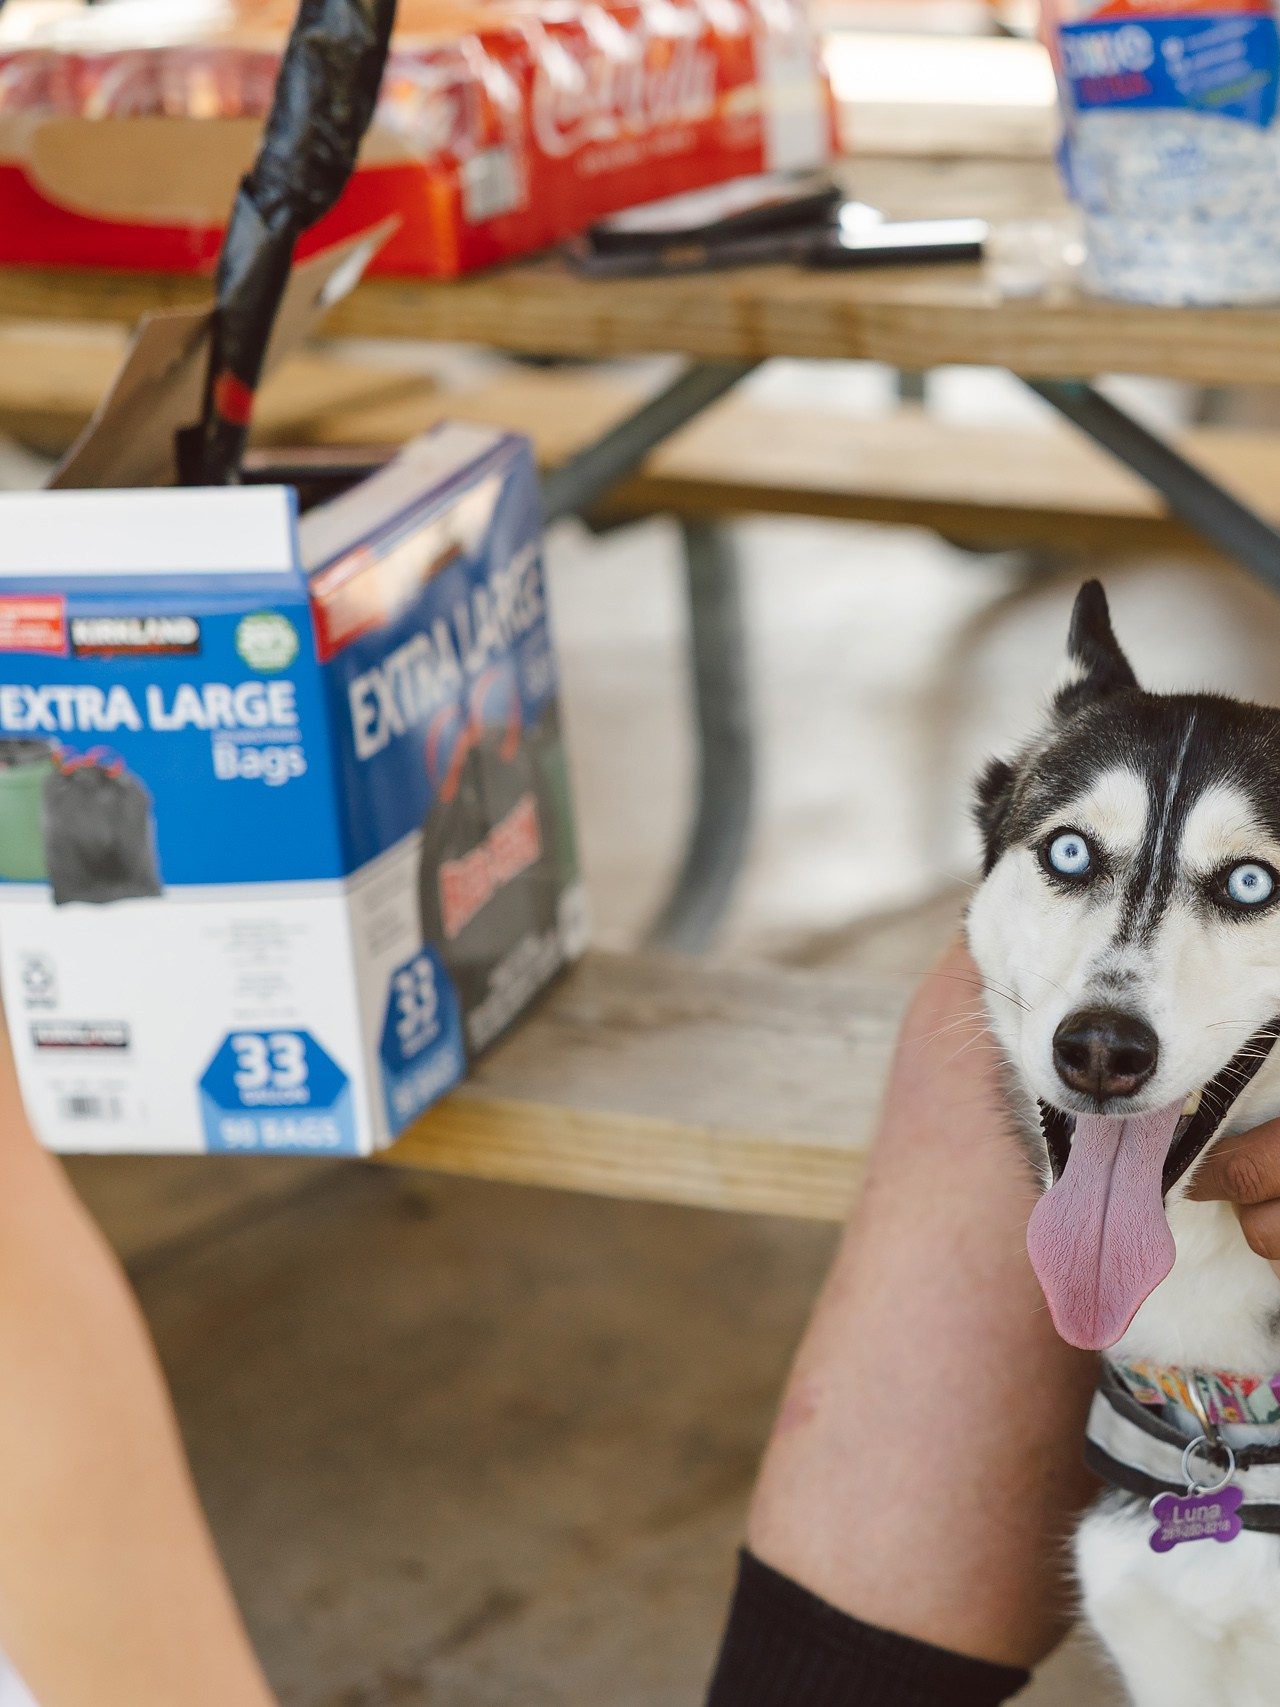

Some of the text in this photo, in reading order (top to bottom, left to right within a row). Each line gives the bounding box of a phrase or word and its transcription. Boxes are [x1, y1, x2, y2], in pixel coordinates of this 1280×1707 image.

[0, 680, 299, 732] EXTRA LARGE
[212, 741, 306, 786] Bags
[231, 1033, 308, 1089] 33
[261, 1116, 340, 1147] BAGS
[1173, 1504, 1221, 1523] Luna
